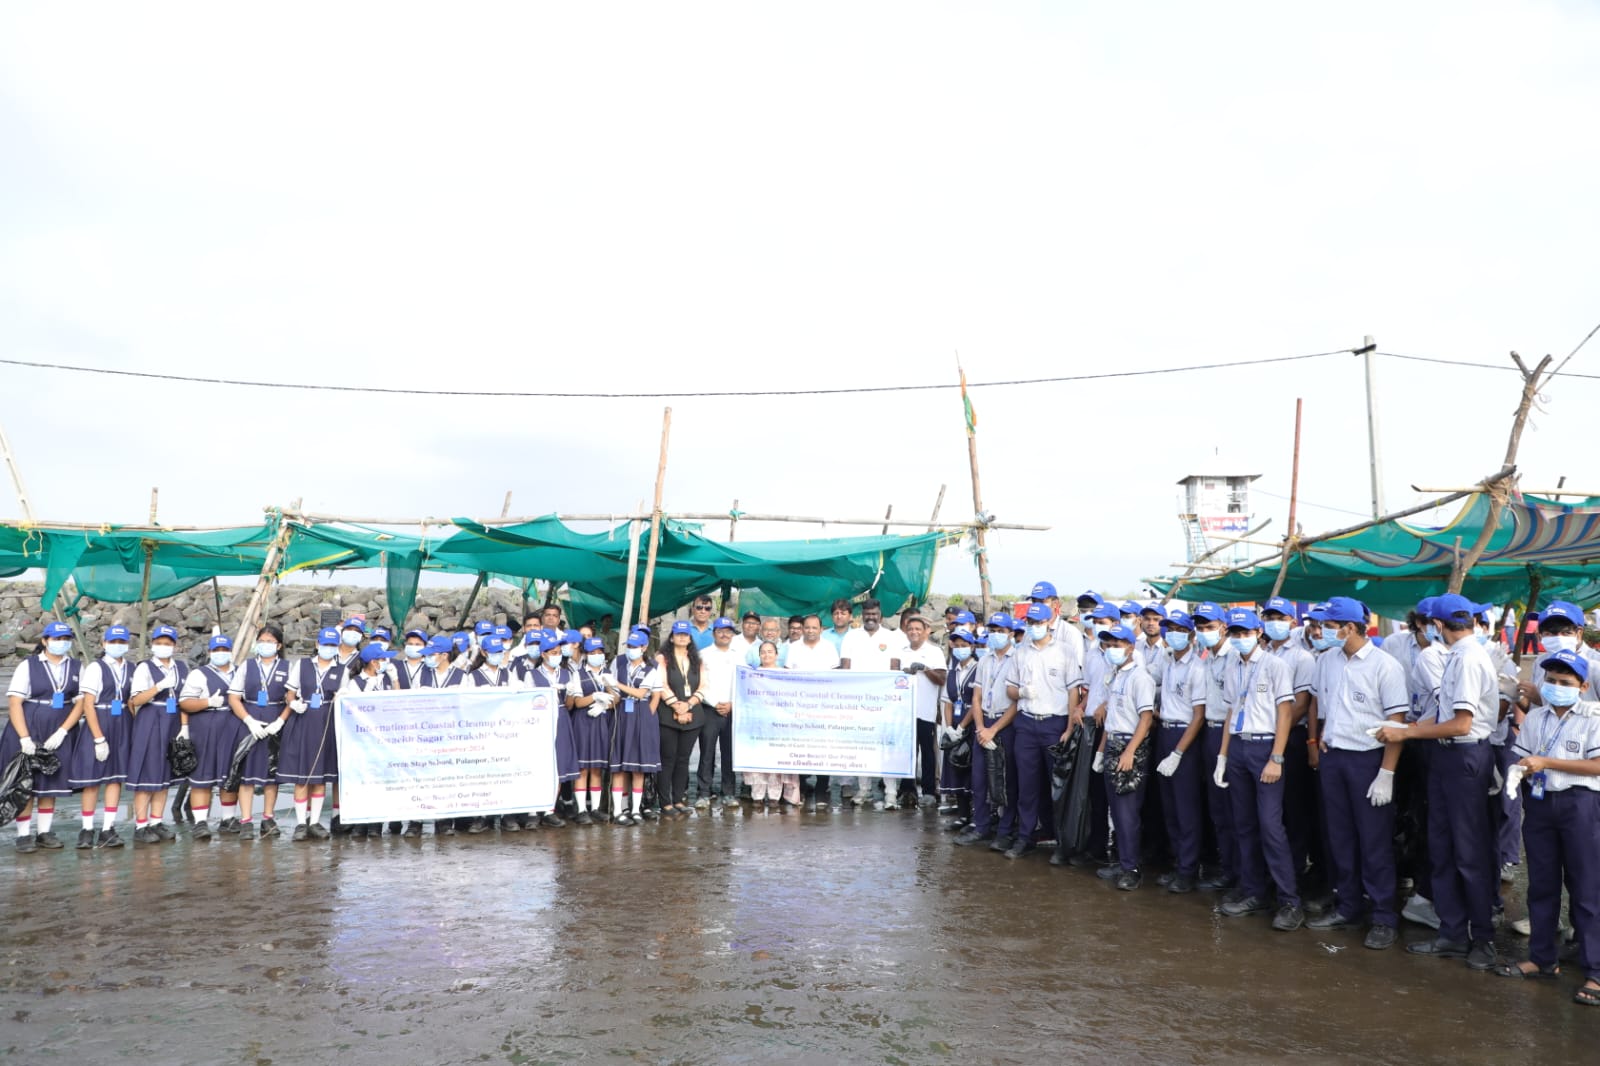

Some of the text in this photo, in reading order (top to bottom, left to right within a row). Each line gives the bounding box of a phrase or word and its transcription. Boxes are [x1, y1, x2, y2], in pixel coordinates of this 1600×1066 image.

[747, 688, 902, 702] International Coastal Cleanup Day-2024
[796, 702, 818, 710] Sagar
[820, 702, 858, 711] Surakshit
[860, 704, 884, 712] Sagar
[356, 722, 418, 733] Intrnational
[420, 720, 456, 730] Coastal
[458, 718, 496, 730] Cleanup
[416, 734, 444, 744] Sagar
